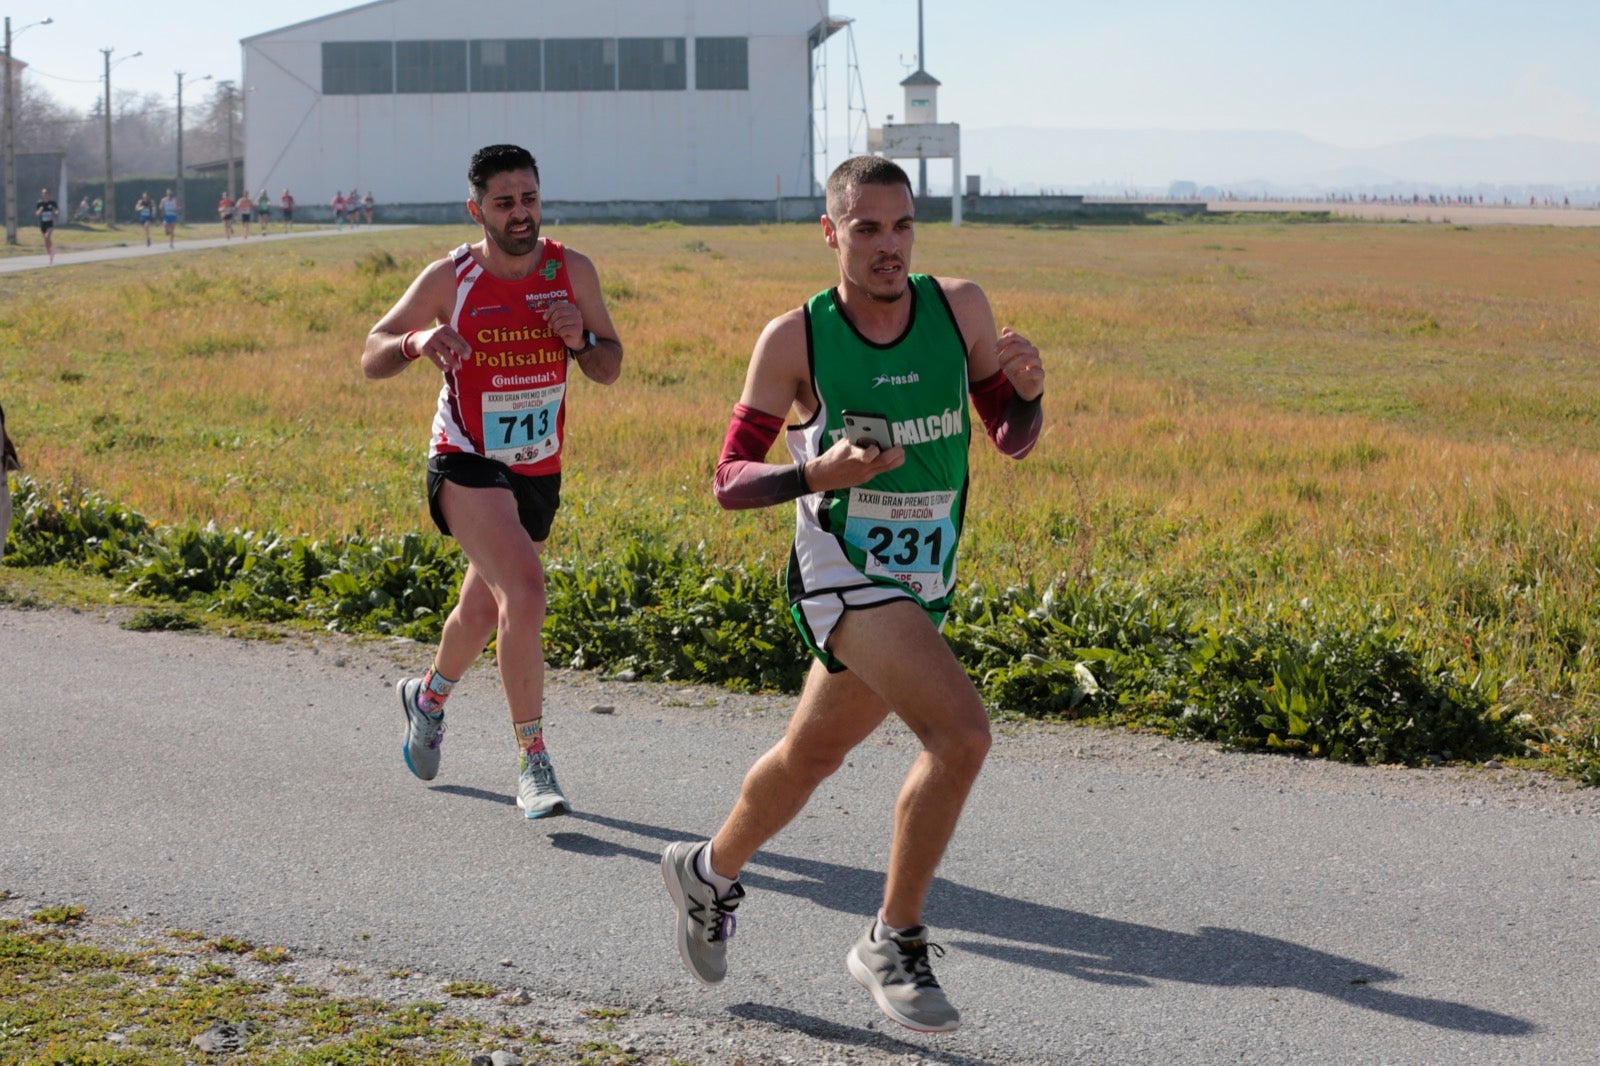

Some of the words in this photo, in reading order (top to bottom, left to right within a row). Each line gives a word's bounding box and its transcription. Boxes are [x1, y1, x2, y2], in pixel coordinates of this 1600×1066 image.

[526, 289, 568, 301] MotorDOS
[477, 325, 556, 344] Clínica
[475, 348, 565, 367] Polisalud
[492, 371, 550, 388] Continental
[890, 371, 919, 386] rasán
[505, 393, 520, 402] GRAN
[521, 391, 541, 400] PREMIO
[499, 409, 549, 444] 713
[859, 493, 880, 504] XXXIII
[882, 496, 903, 507] GRAN
[904, 496, 929, 507] PREMIO
[891, 507, 933, 519] DIPUTACIÓN
[867, 526, 942, 566] 231
